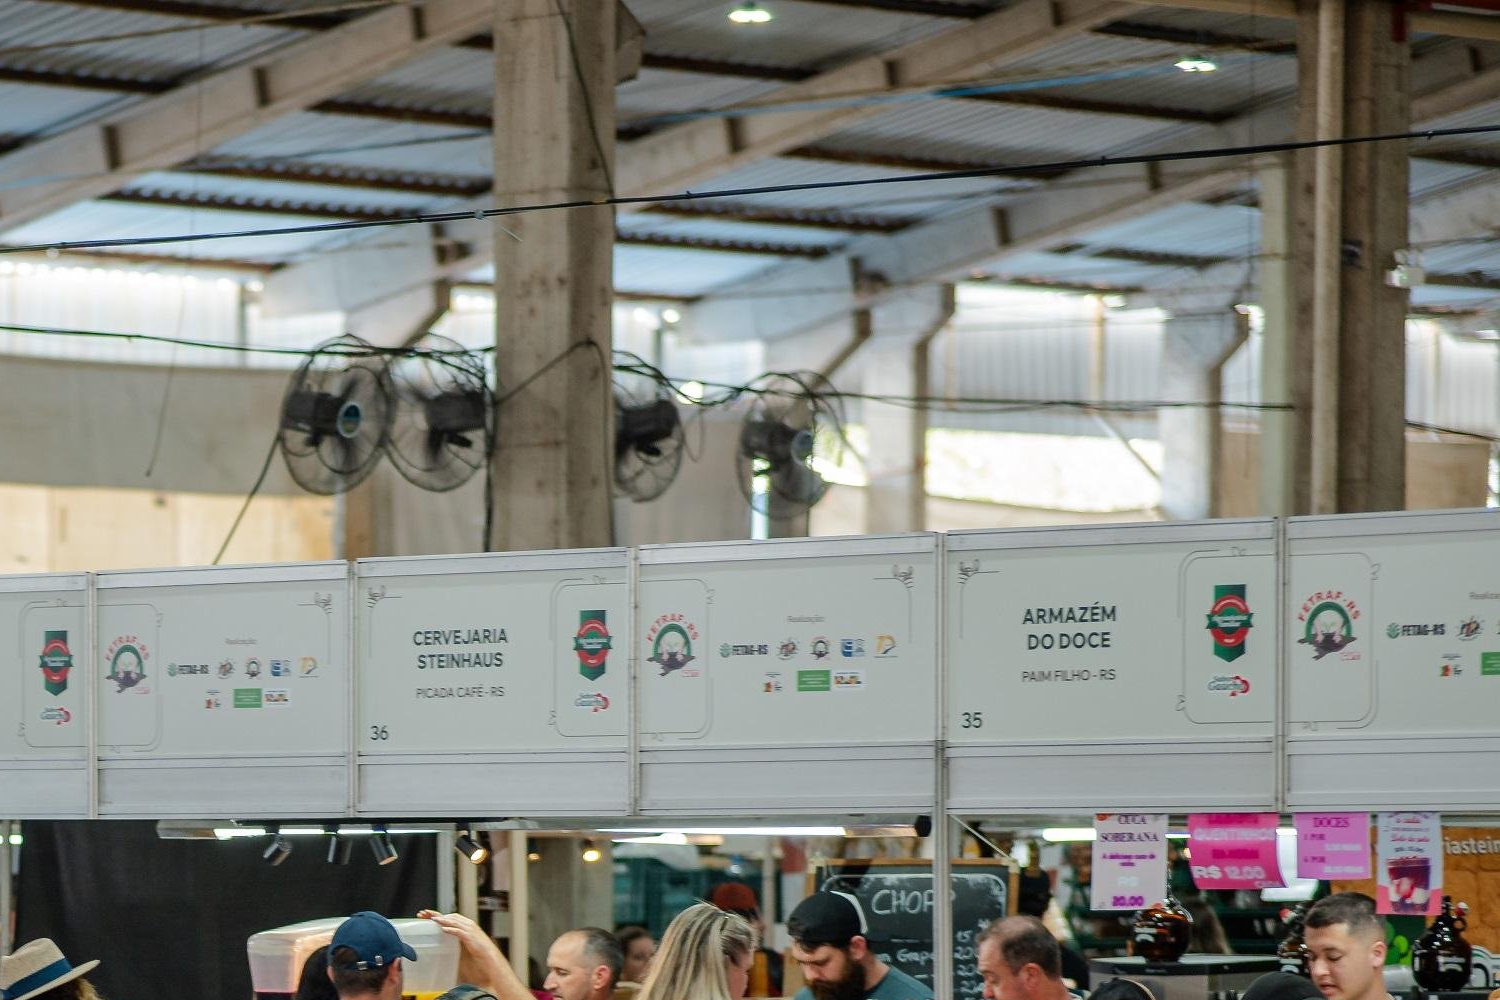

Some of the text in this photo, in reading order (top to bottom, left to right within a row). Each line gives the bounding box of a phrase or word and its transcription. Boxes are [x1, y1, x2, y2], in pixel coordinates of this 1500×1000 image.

[1022, 601, 1117, 624] ARMAZÉM
[413, 628, 508, 646] CERVEJARIA
[1027, 632, 1111, 650] DO DOCE
[418, 652, 504, 669] STEINHAUS
[1022, 671, 1052, 682] PAIM
[1054, 669, 1091, 682] FILHO
[1100, 668, 1116, 681] RS
[415, 687, 454, 699] PICADA
[457, 684, 483, 698] CAFÉ
[490, 686, 504, 697] RS
[962, 711, 983, 729] 35
[371, 725, 389, 741] 36
[1313, 817, 1349, 828] DOCES
[1100, 832, 1159, 842] SOBERANA
